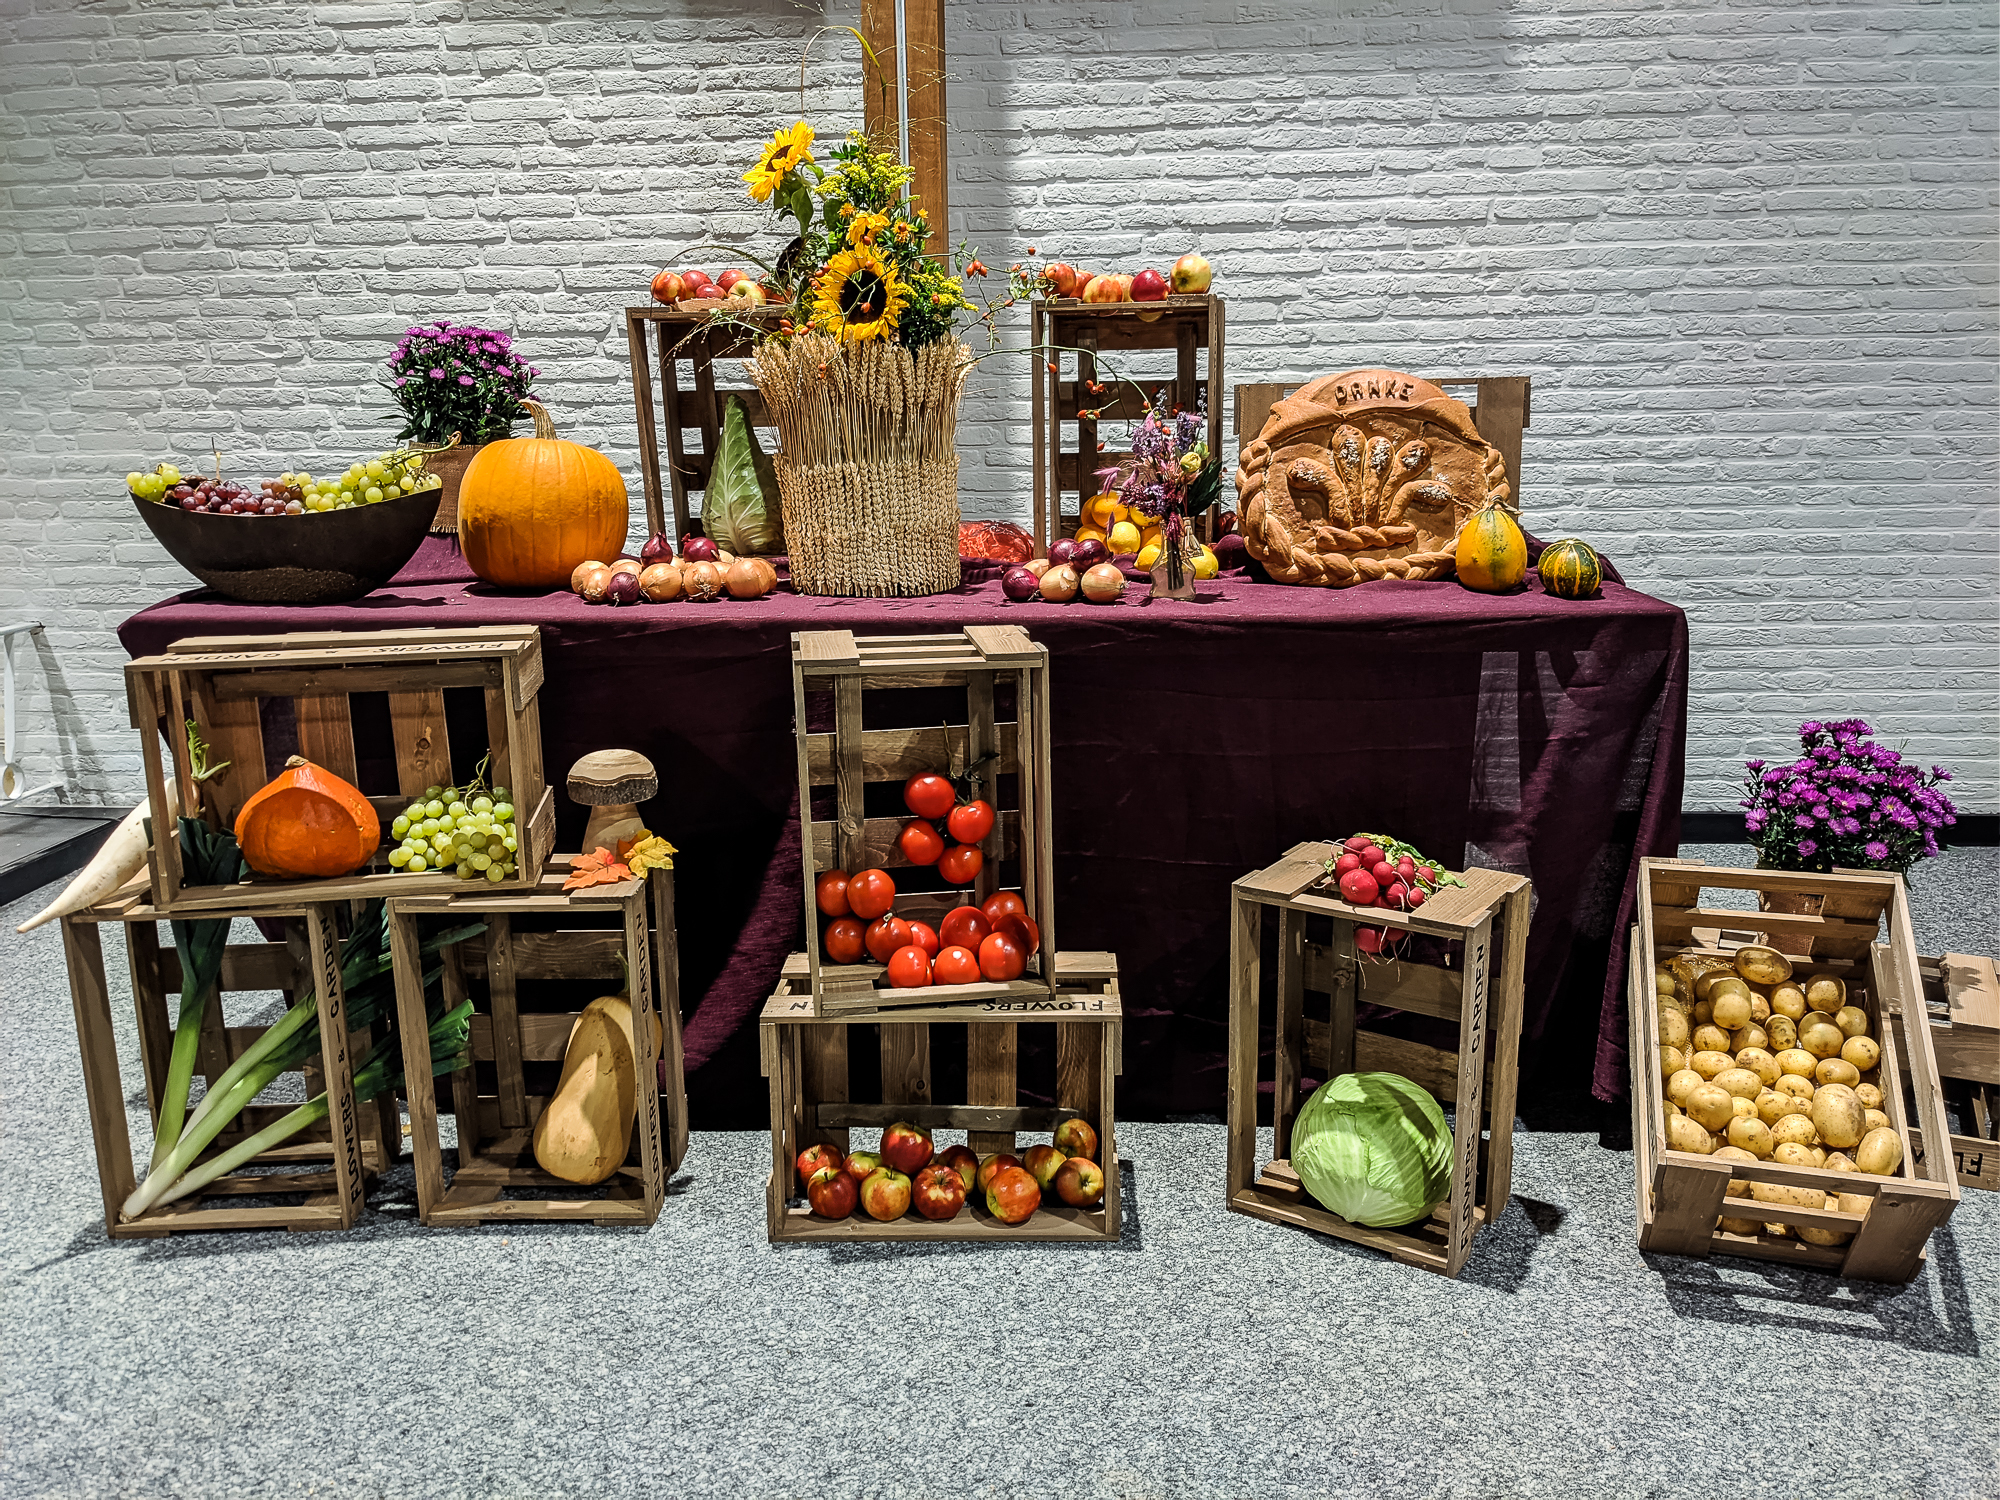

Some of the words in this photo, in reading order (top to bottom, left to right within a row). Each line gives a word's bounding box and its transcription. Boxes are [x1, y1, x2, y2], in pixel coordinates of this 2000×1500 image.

[1335, 380, 1414, 407] DANKE
[159, 653, 281, 662] GARDEN
[373, 642, 504, 653] FLOWERS
[320, 917, 340, 1018] GARDEN
[636, 912, 649, 1014] GARDEN
[982, 1000, 1103, 1012] FLOWERS
[341, 1092, 363, 1204] FLOWERS
[648, 1089, 661, 1202] FLOWERS
[1460, 1133, 1476, 1252] FLOWERS
[1471, 943, 1485, 1054] GARDEN
